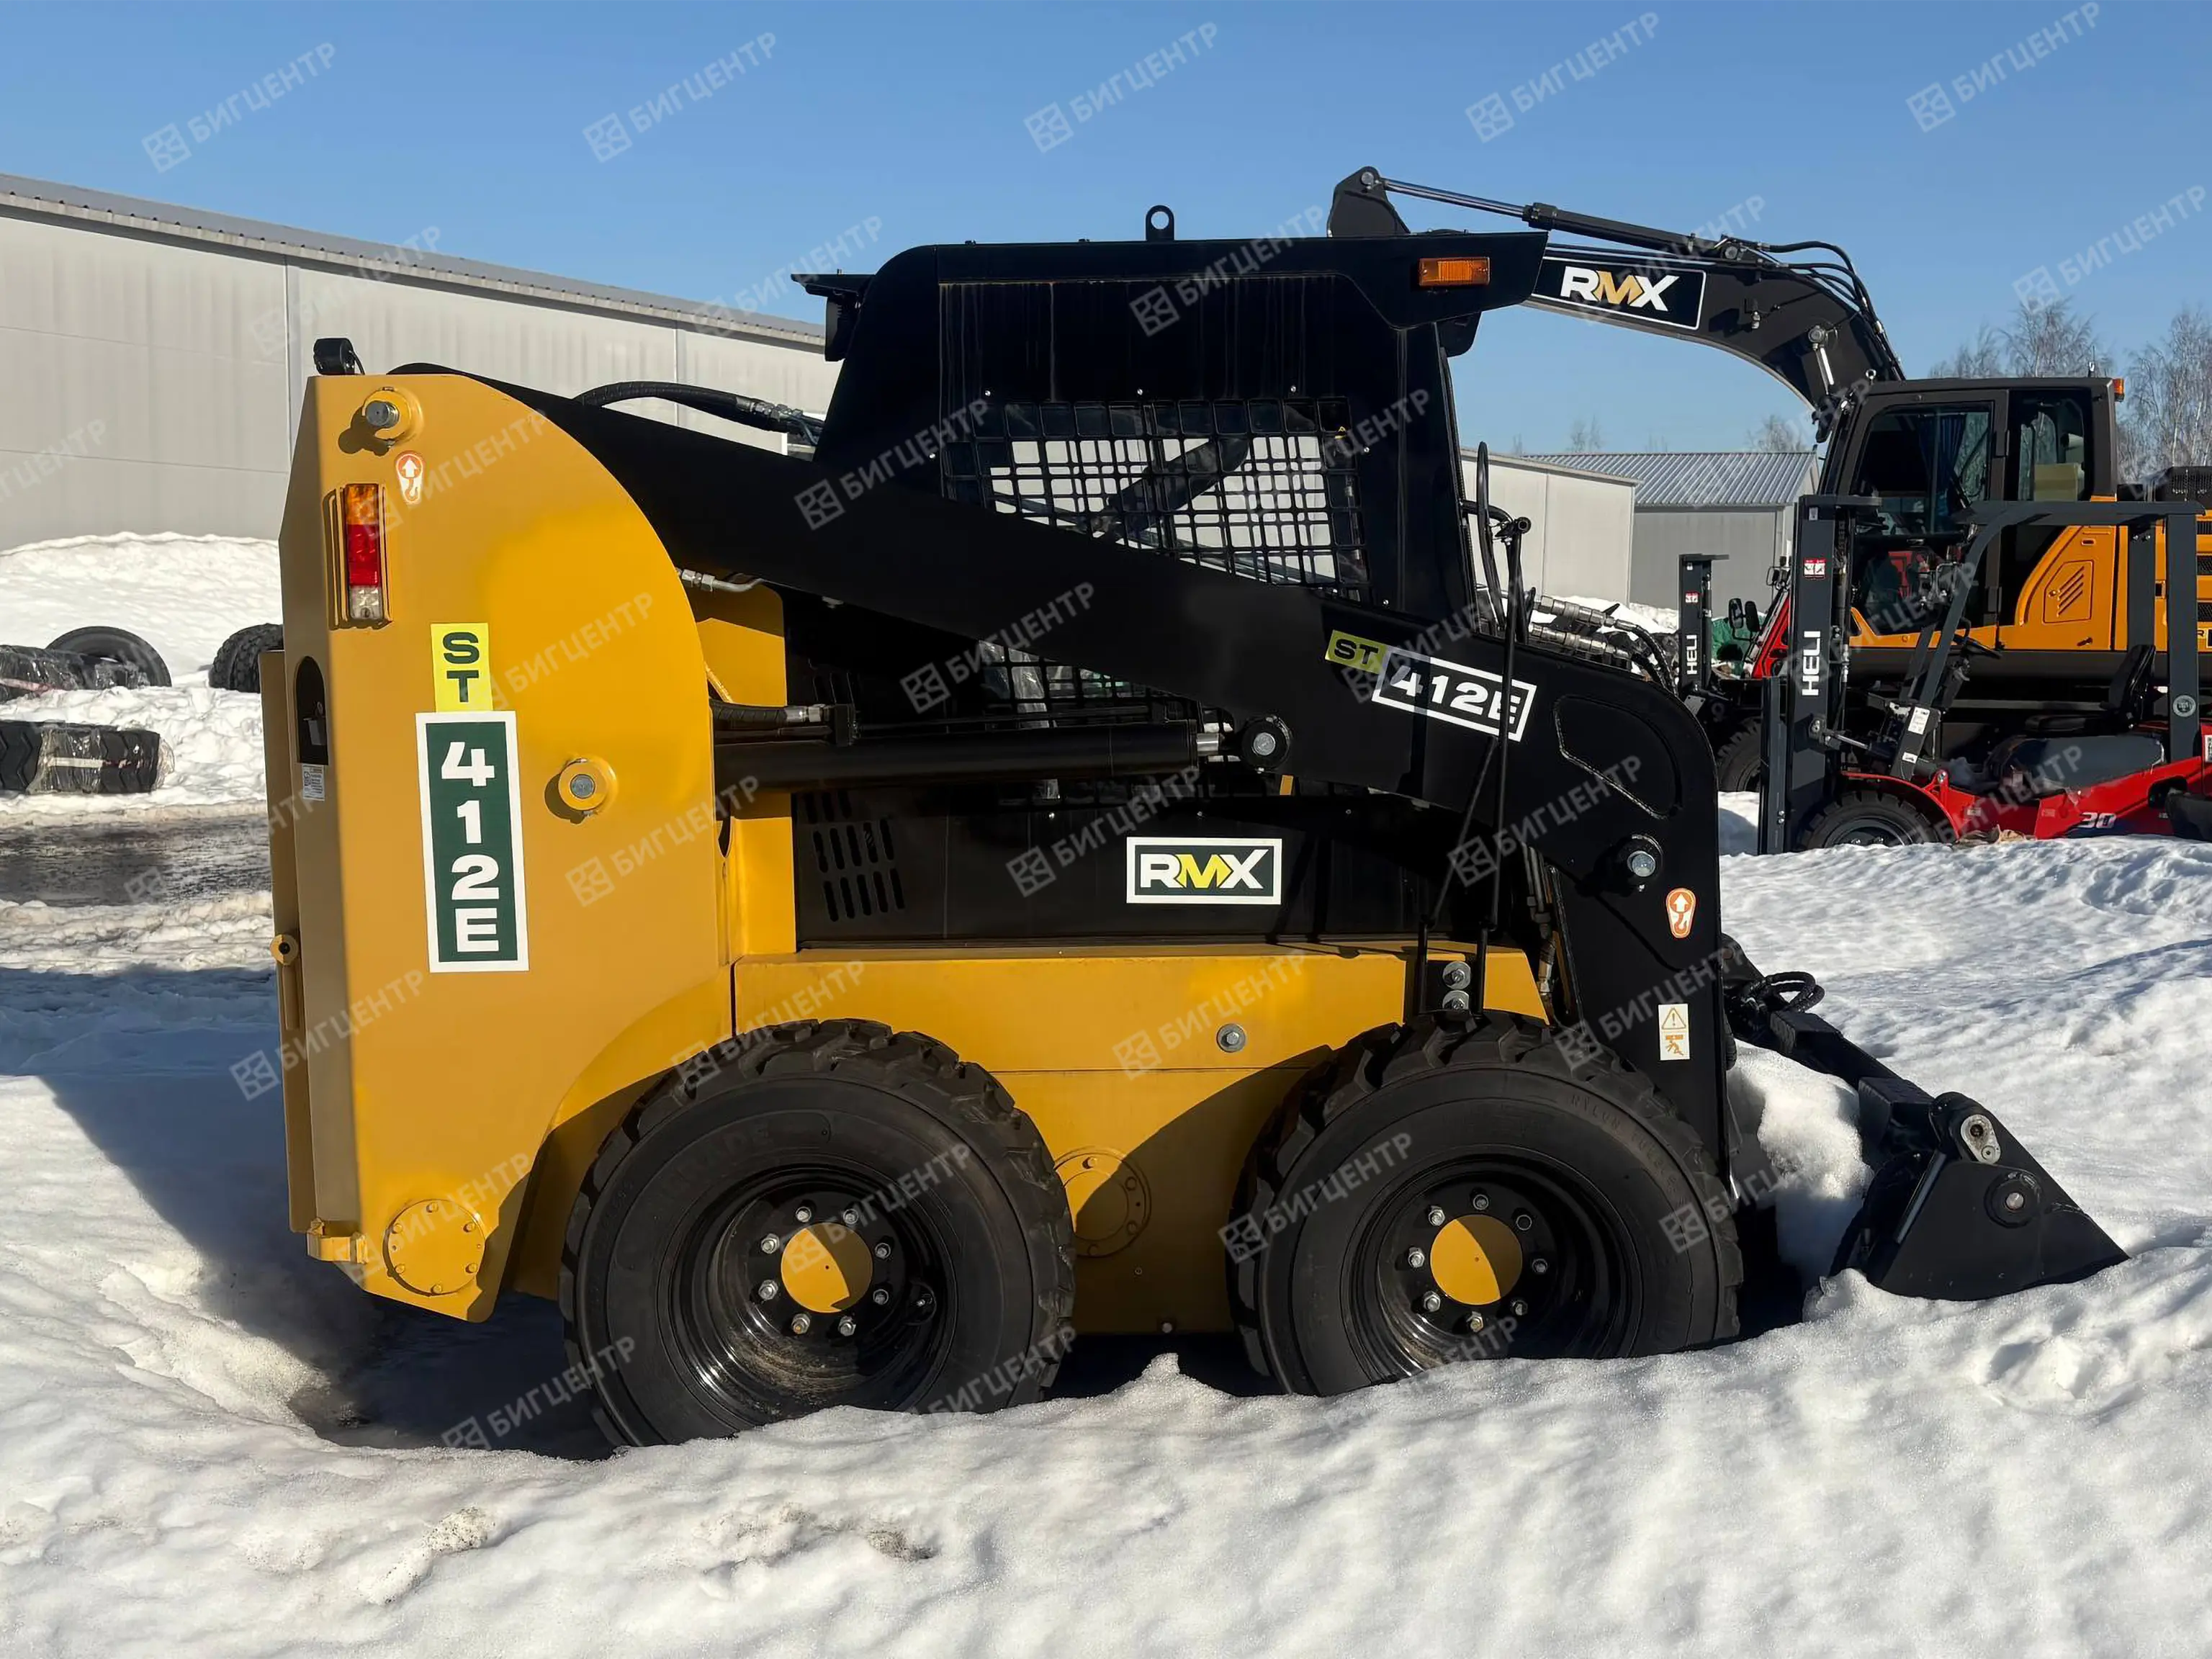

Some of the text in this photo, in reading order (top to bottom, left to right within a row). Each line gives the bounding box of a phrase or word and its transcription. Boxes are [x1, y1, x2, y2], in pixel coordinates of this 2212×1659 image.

[1560, 266, 1680, 312] RMX
[442, 631, 480, 703] ST
[1334, 639, 1521, 724] ST 412E
[1686, 634, 1698, 675] HELI
[1802, 631, 1821, 696] HELI
[441, 741, 500, 953] 412E
[1140, 849, 1269, 889] RMX
